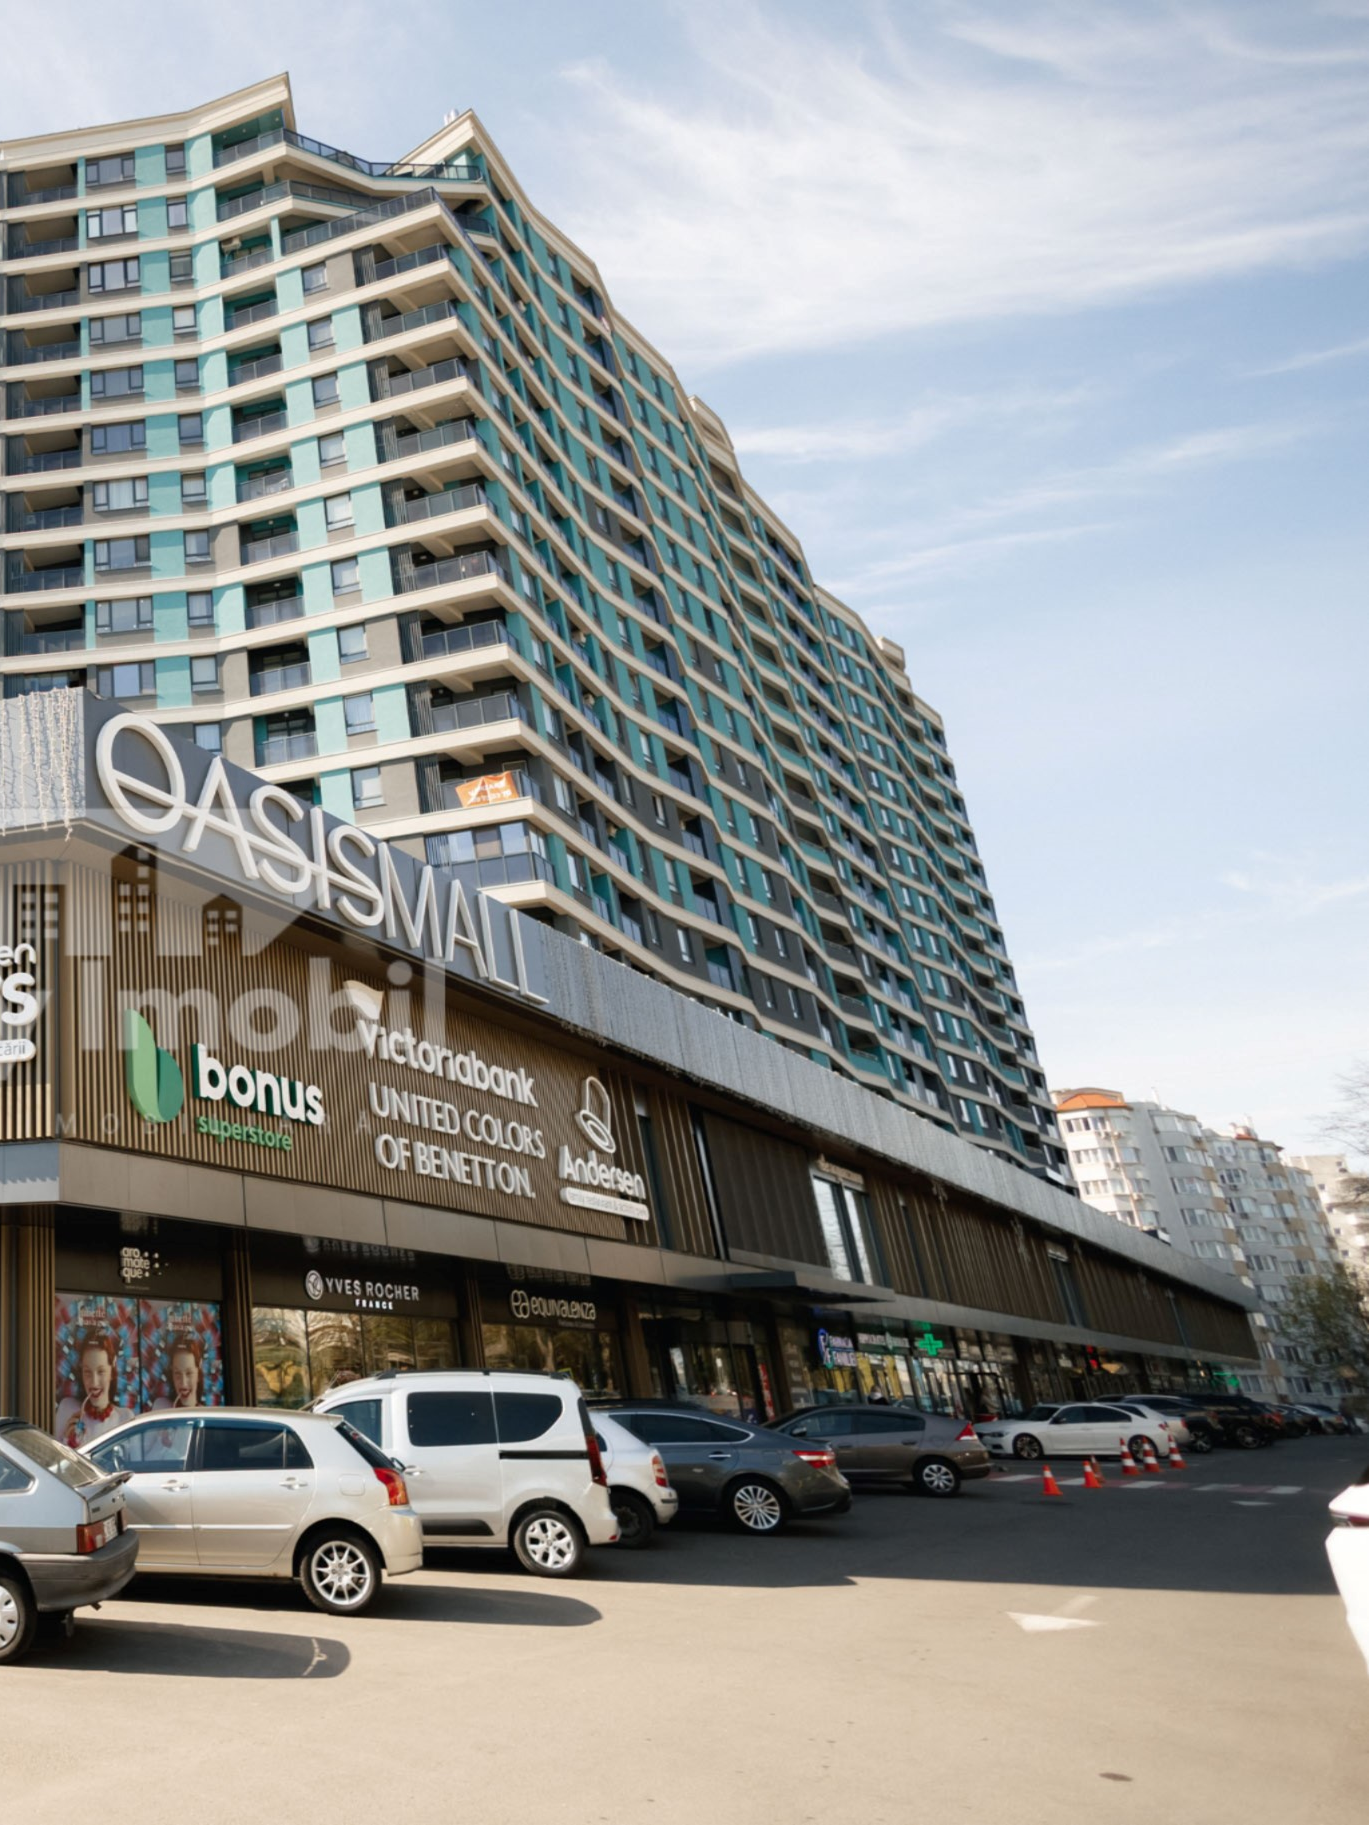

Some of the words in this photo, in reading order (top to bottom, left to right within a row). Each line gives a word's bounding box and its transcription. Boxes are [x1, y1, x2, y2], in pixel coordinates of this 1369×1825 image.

[191, 1042, 326, 1127] bonus
[356, 1019, 539, 1109] Victoriabank
[196, 1115, 293, 1152] superstore
[368, 1081, 461, 1135] UNITED
[461, 1109, 547, 1161] COLORS
[374, 1133, 412, 1172] OF
[559, 1144, 647, 1200] Andersen
[325, 1276, 362, 1297] YVES
[365, 1281, 420, 1302] ROCHER
[355, 1298, 394, 1310] FRANCE
